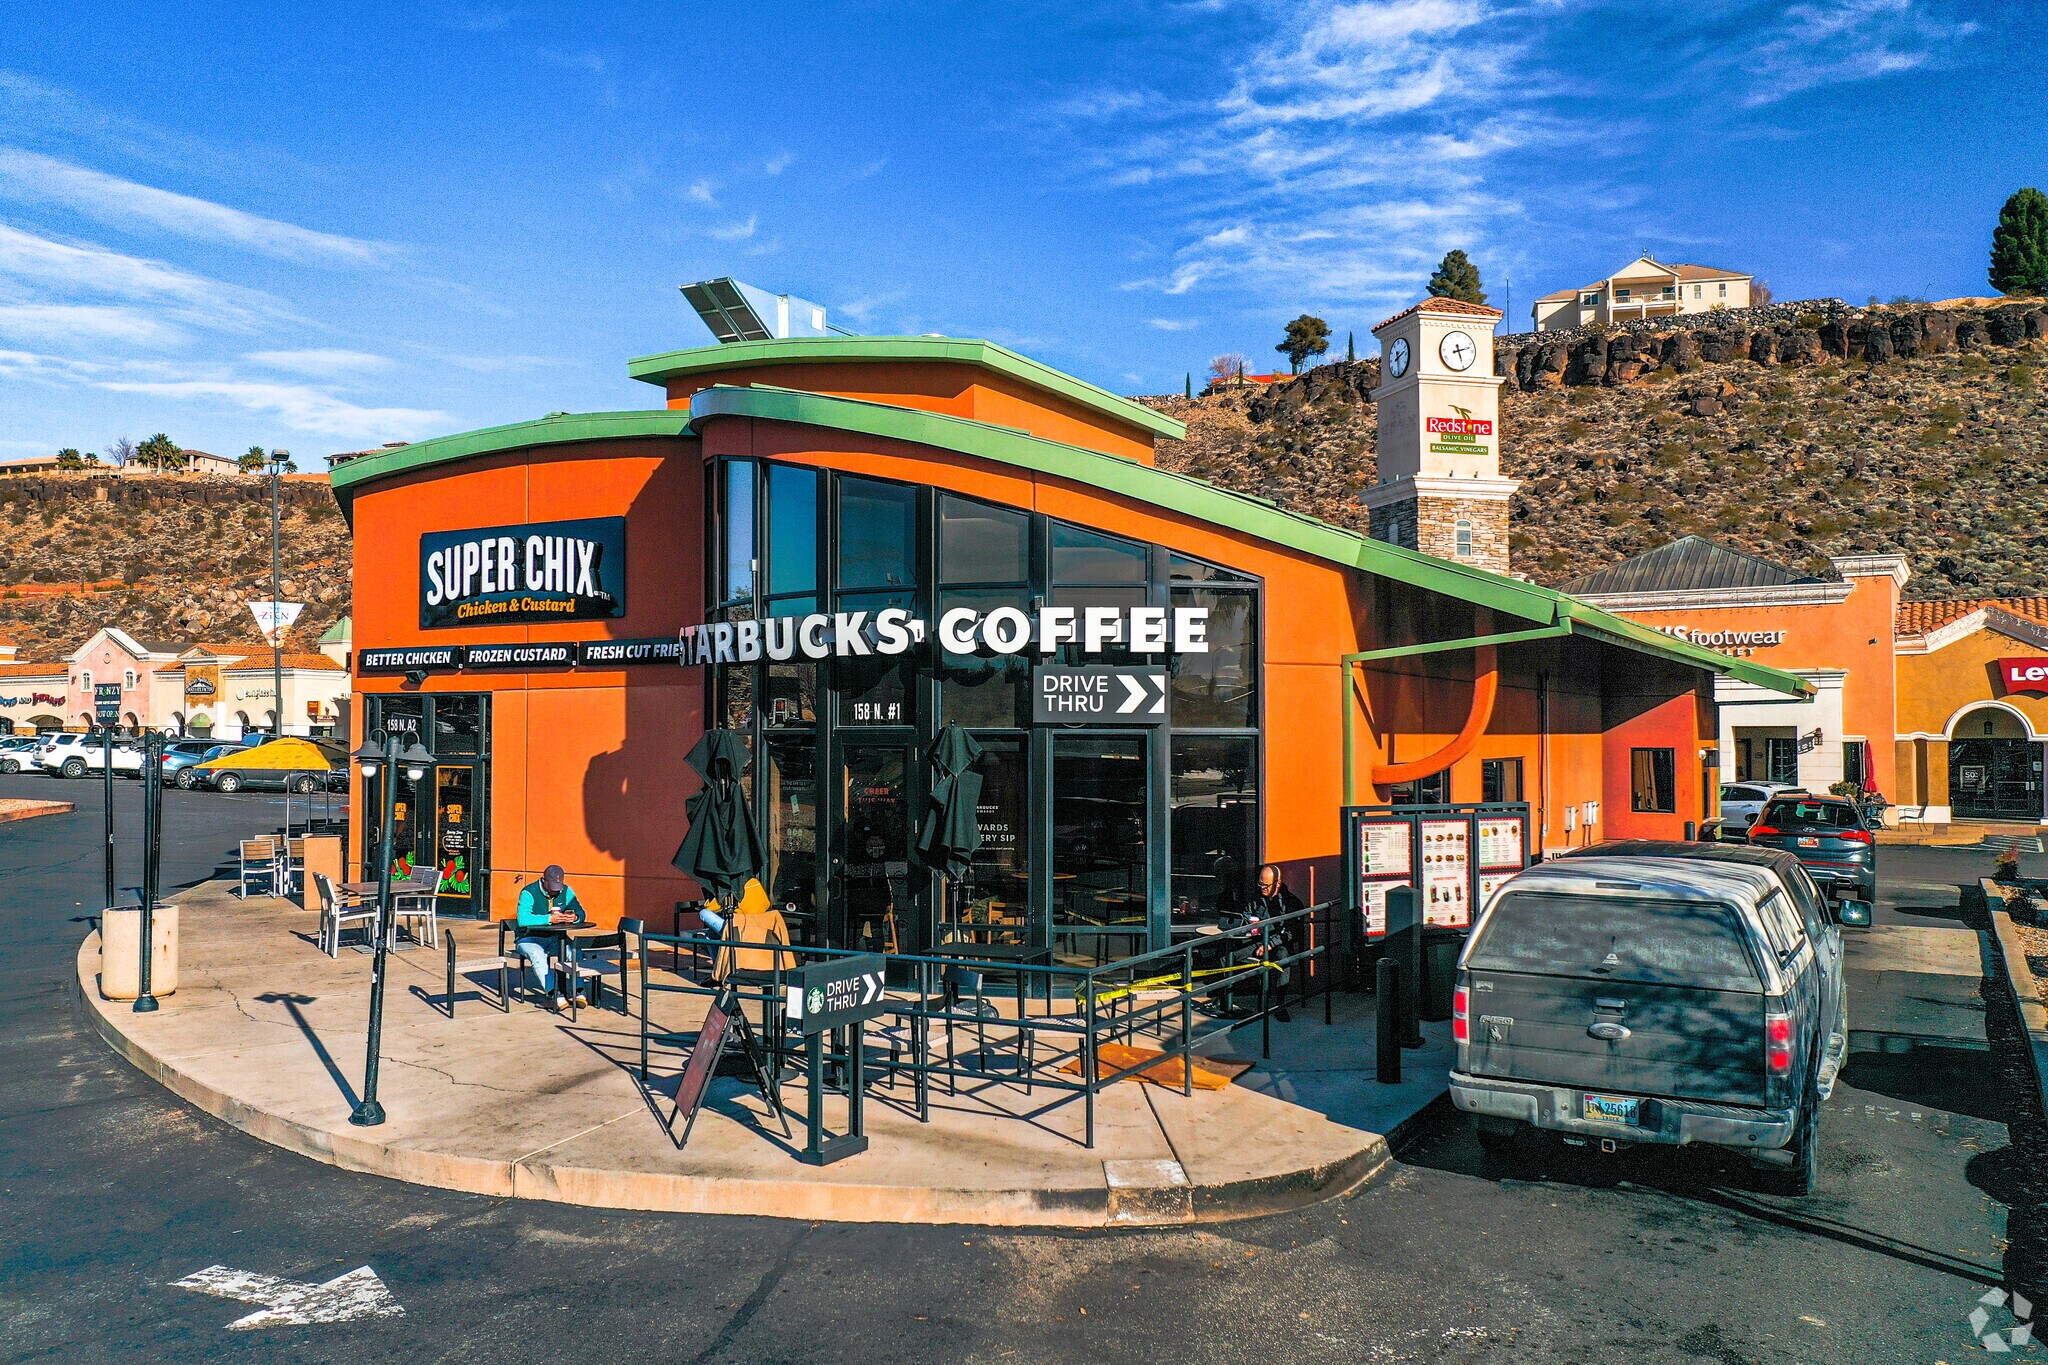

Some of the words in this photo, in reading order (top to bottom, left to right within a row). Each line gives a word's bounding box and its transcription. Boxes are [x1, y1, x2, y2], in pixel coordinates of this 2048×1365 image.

[426, 536, 516, 606] SUPER
[457, 599, 507, 618] Chicken
[509, 600, 520, 612] &
[521, 597, 575, 613] Custard
[679, 608, 914, 667] STARBUCKS
[938, 606, 1209, 655] COFFEE
[1690, 629, 1788, 646] footwear
[365, 652, 405, 666] BETTER
[405, 650, 451, 665] CHICKEN
[468, 649, 512, 663] FROZEN
[512, 647, 567, 661] CUSTARD
[586, 645, 624, 659] FRESH
[626, 644, 651, 658] CUT
[653, 643, 683, 657] FRIE
[1043, 675, 1109, 694] DRIVE
[854, 703, 870, 720] 158
[873, 703, 885, 719] N.
[888, 702, 901, 719] #1
[1044, 694, 1104, 713] THRU
[387, 718, 398, 732] 158
[399, 718, 407, 731] N.
[407, 718, 417, 732] A2
[864, 787, 889, 795] CHEER
[980, 834, 998, 842] ERY
[1000, 834, 1016, 842] SIP
[826, 976, 860, 997] DRIVE
[826, 993, 857, 1013] THRU
[1599, 1027, 1617, 1036] Ford
